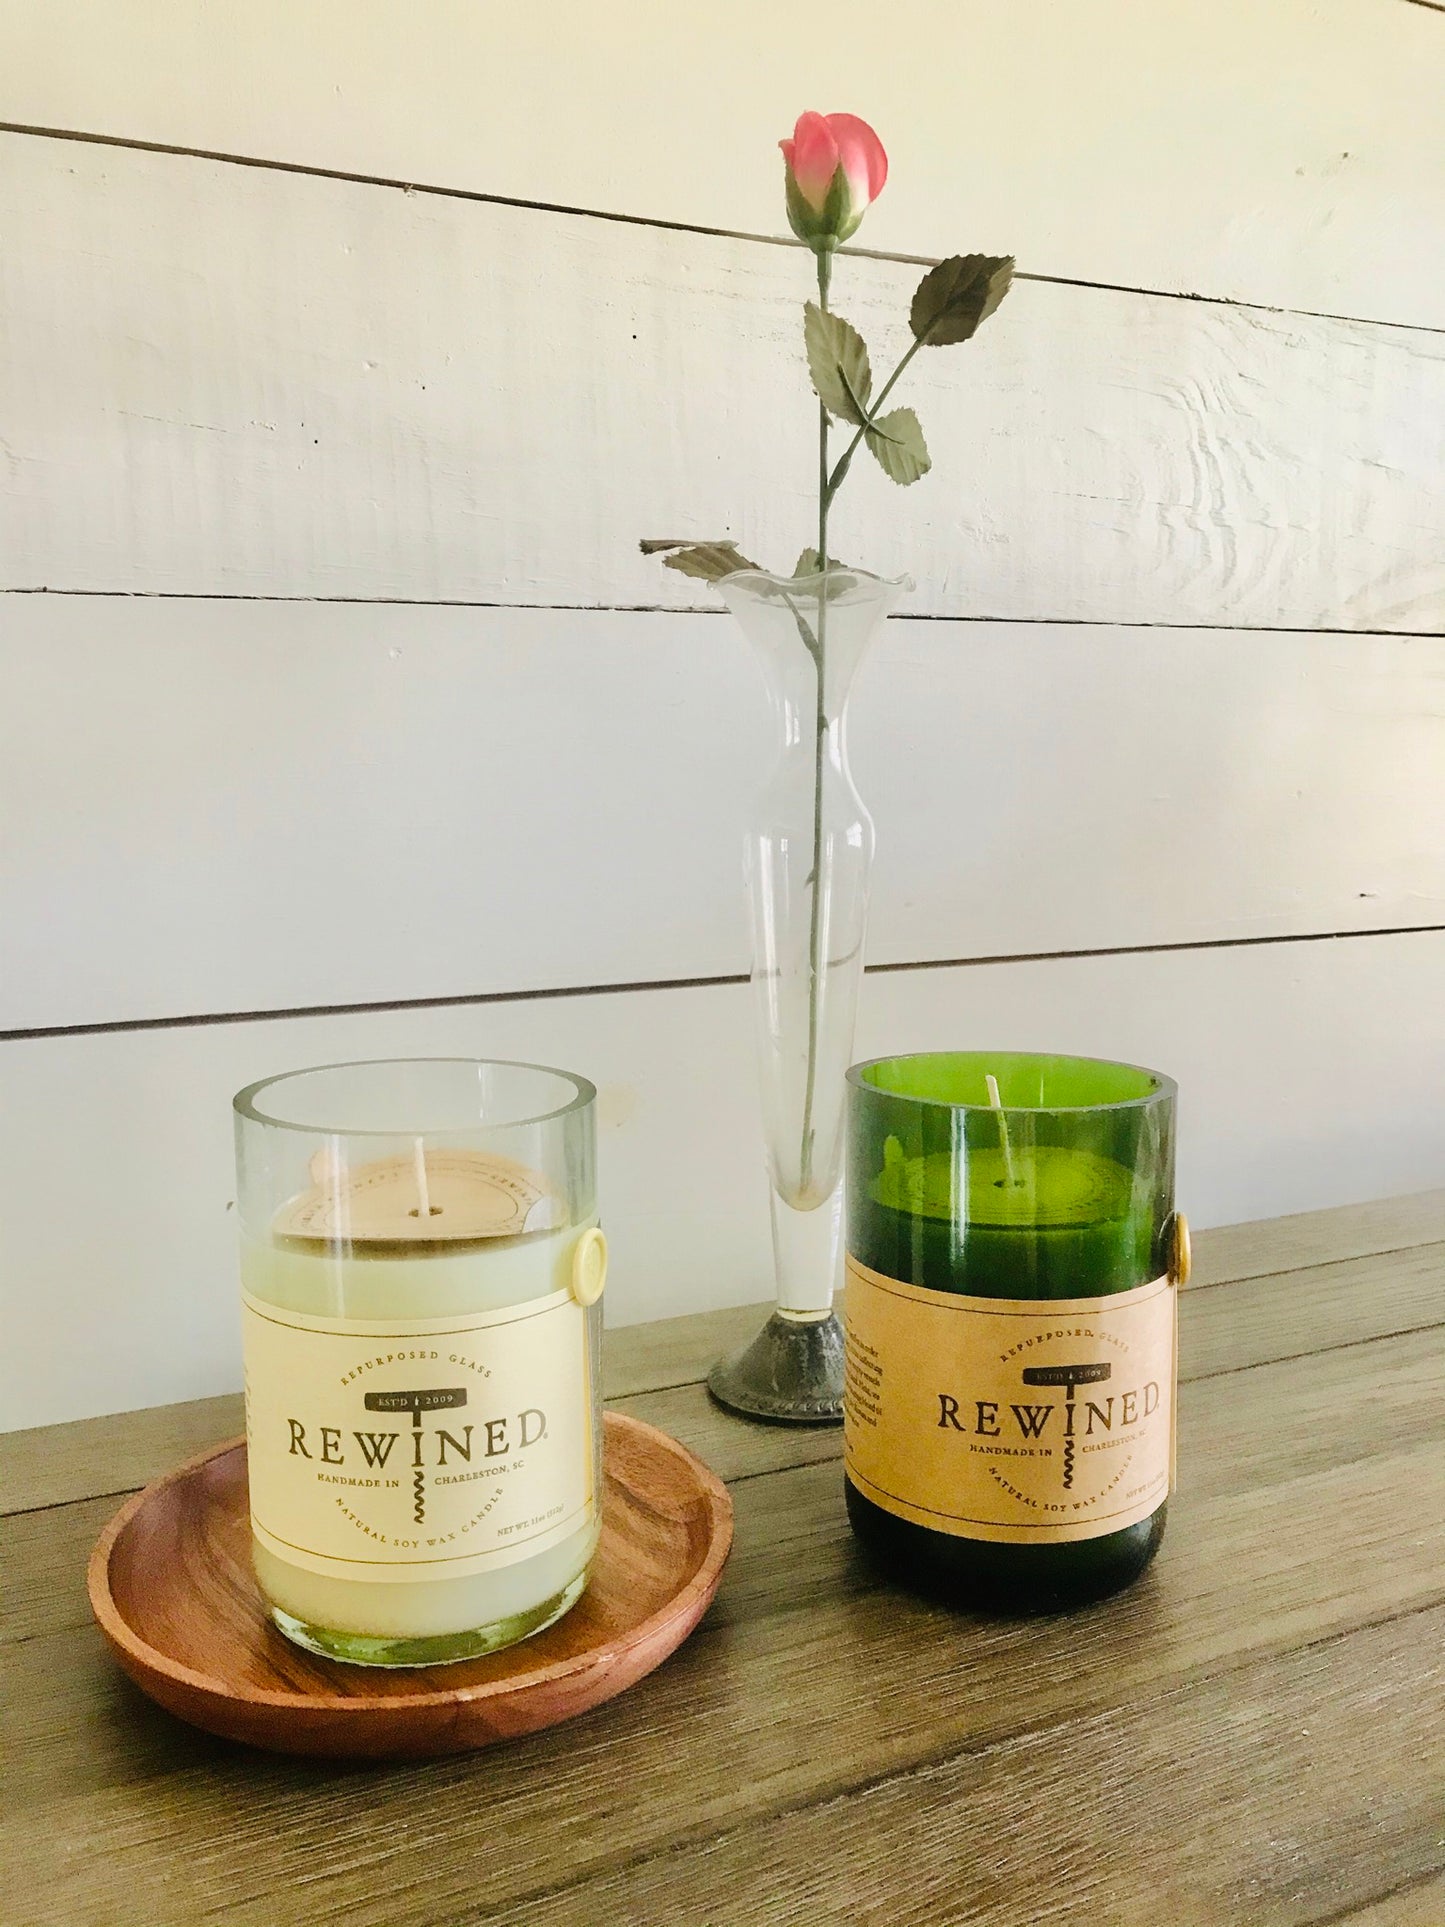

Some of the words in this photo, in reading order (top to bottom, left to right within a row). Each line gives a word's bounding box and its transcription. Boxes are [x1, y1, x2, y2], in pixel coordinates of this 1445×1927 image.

[340, 1350, 439, 1386] REPURPOSED
[448, 1353, 492, 1379] GLASS
[425, 1394, 454, 1406] 2009
[937, 1381, 1160, 1438] REWINED
[969, 1443, 1035, 1457] HANDMADE
[1038, 1449, 1053, 1457] IN
[317, 1472, 381, 1488] HANDMADE
[385, 1479, 400, 1488] IN
[434, 1464, 510, 1486] CHARLESTON,
[512, 1459, 525, 1470] SC
[988, 1466, 1038, 1508] NATURAL
[1043, 1503, 1067, 1512] SOY
[1072, 1496, 1097, 1510] WAX
[1100, 1455, 1133, 1497] CANDLE
[336, 1498, 387, 1544] NATURAL
[393, 1538, 420, 1549] SOY
[426, 1532, 456, 1547] WAX
[461, 1487, 504, 1533] CANDLE
[497, 1524, 514, 1537] NET
